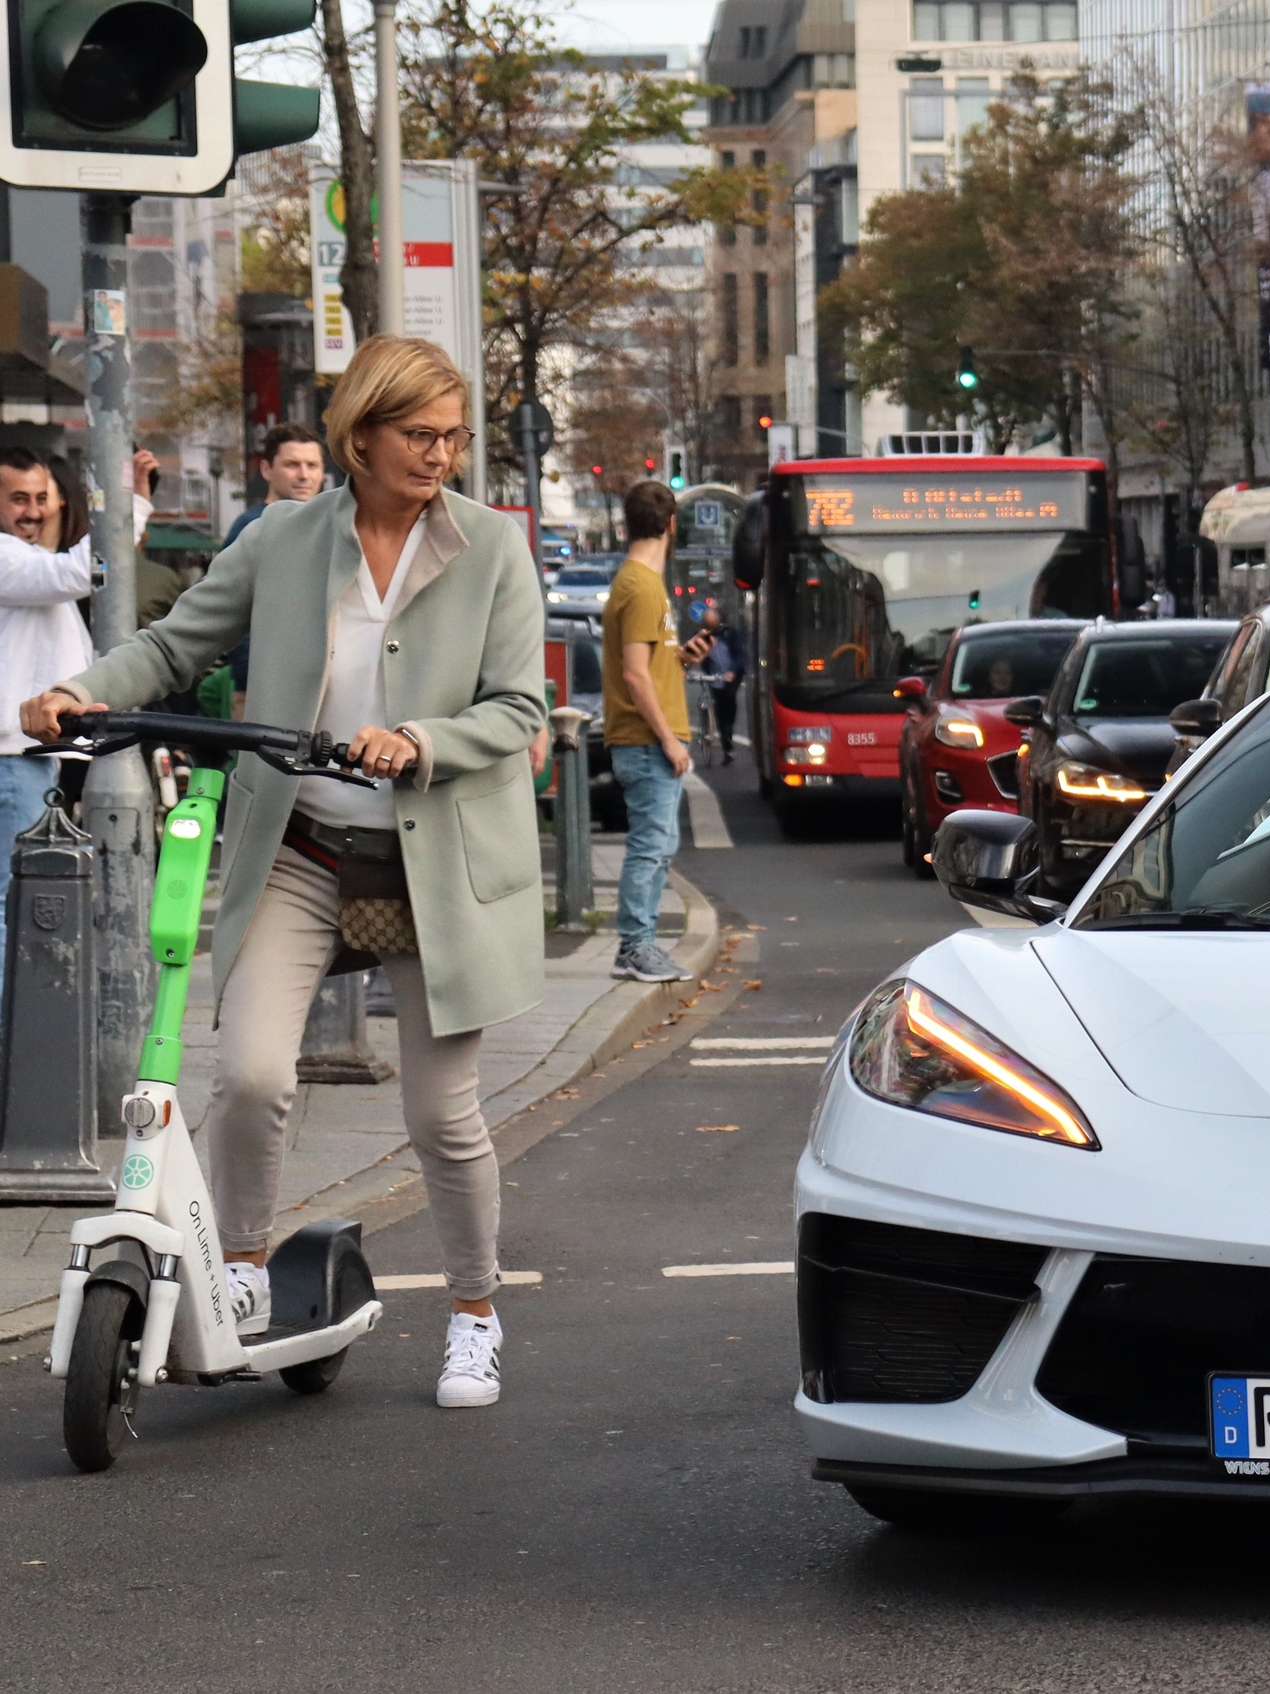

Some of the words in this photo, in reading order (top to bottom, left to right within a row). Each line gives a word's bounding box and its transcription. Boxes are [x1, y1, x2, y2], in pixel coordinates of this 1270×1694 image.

[847, 732, 877, 746] 8355
[189, 1200, 202, 1230] On
[197, 1227, 213, 1272] Lime
[211, 1283, 224, 1327] Uber
[1224, 1426, 1238, 1444] D
[1224, 1460, 1270, 1476] WIENS
